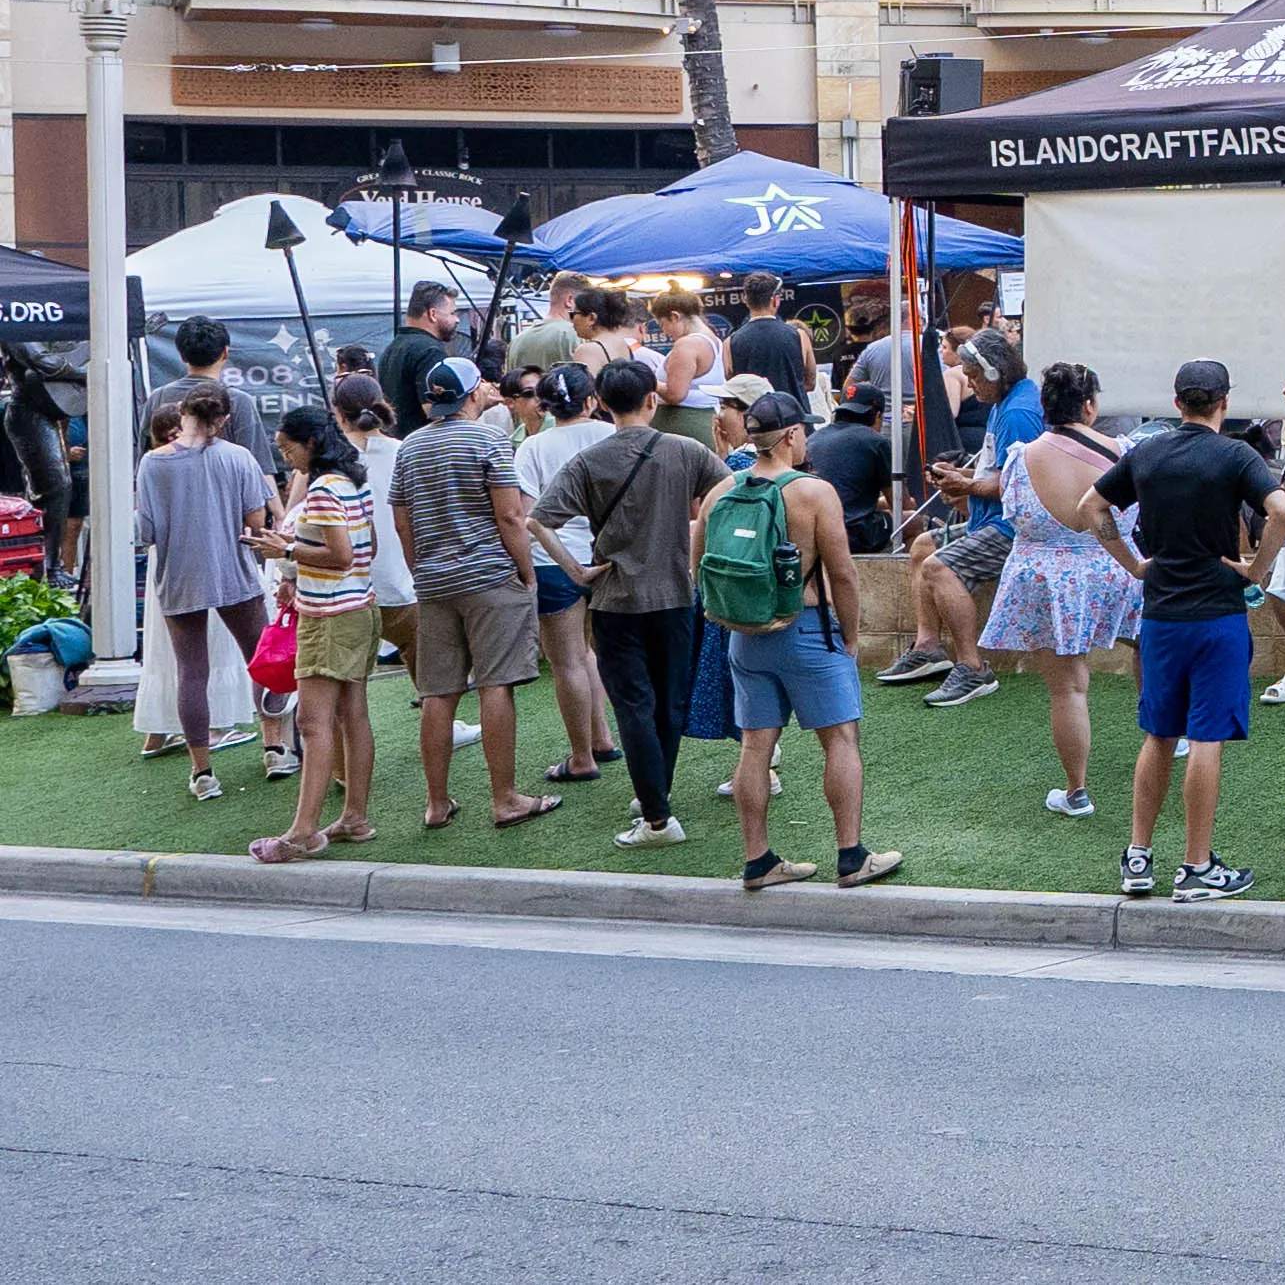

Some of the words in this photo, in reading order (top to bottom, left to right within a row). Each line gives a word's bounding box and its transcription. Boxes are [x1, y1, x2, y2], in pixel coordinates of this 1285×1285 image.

[1128, 80, 1184, 92] CRAFT
[1185, 76, 1241, 88] FAIRS
[421, 169, 458, 179] CLASSIC
[458, 173, 484, 186] ROCK
[0, 301, 64, 322] .ORG
[222, 364, 294, 387] 808
